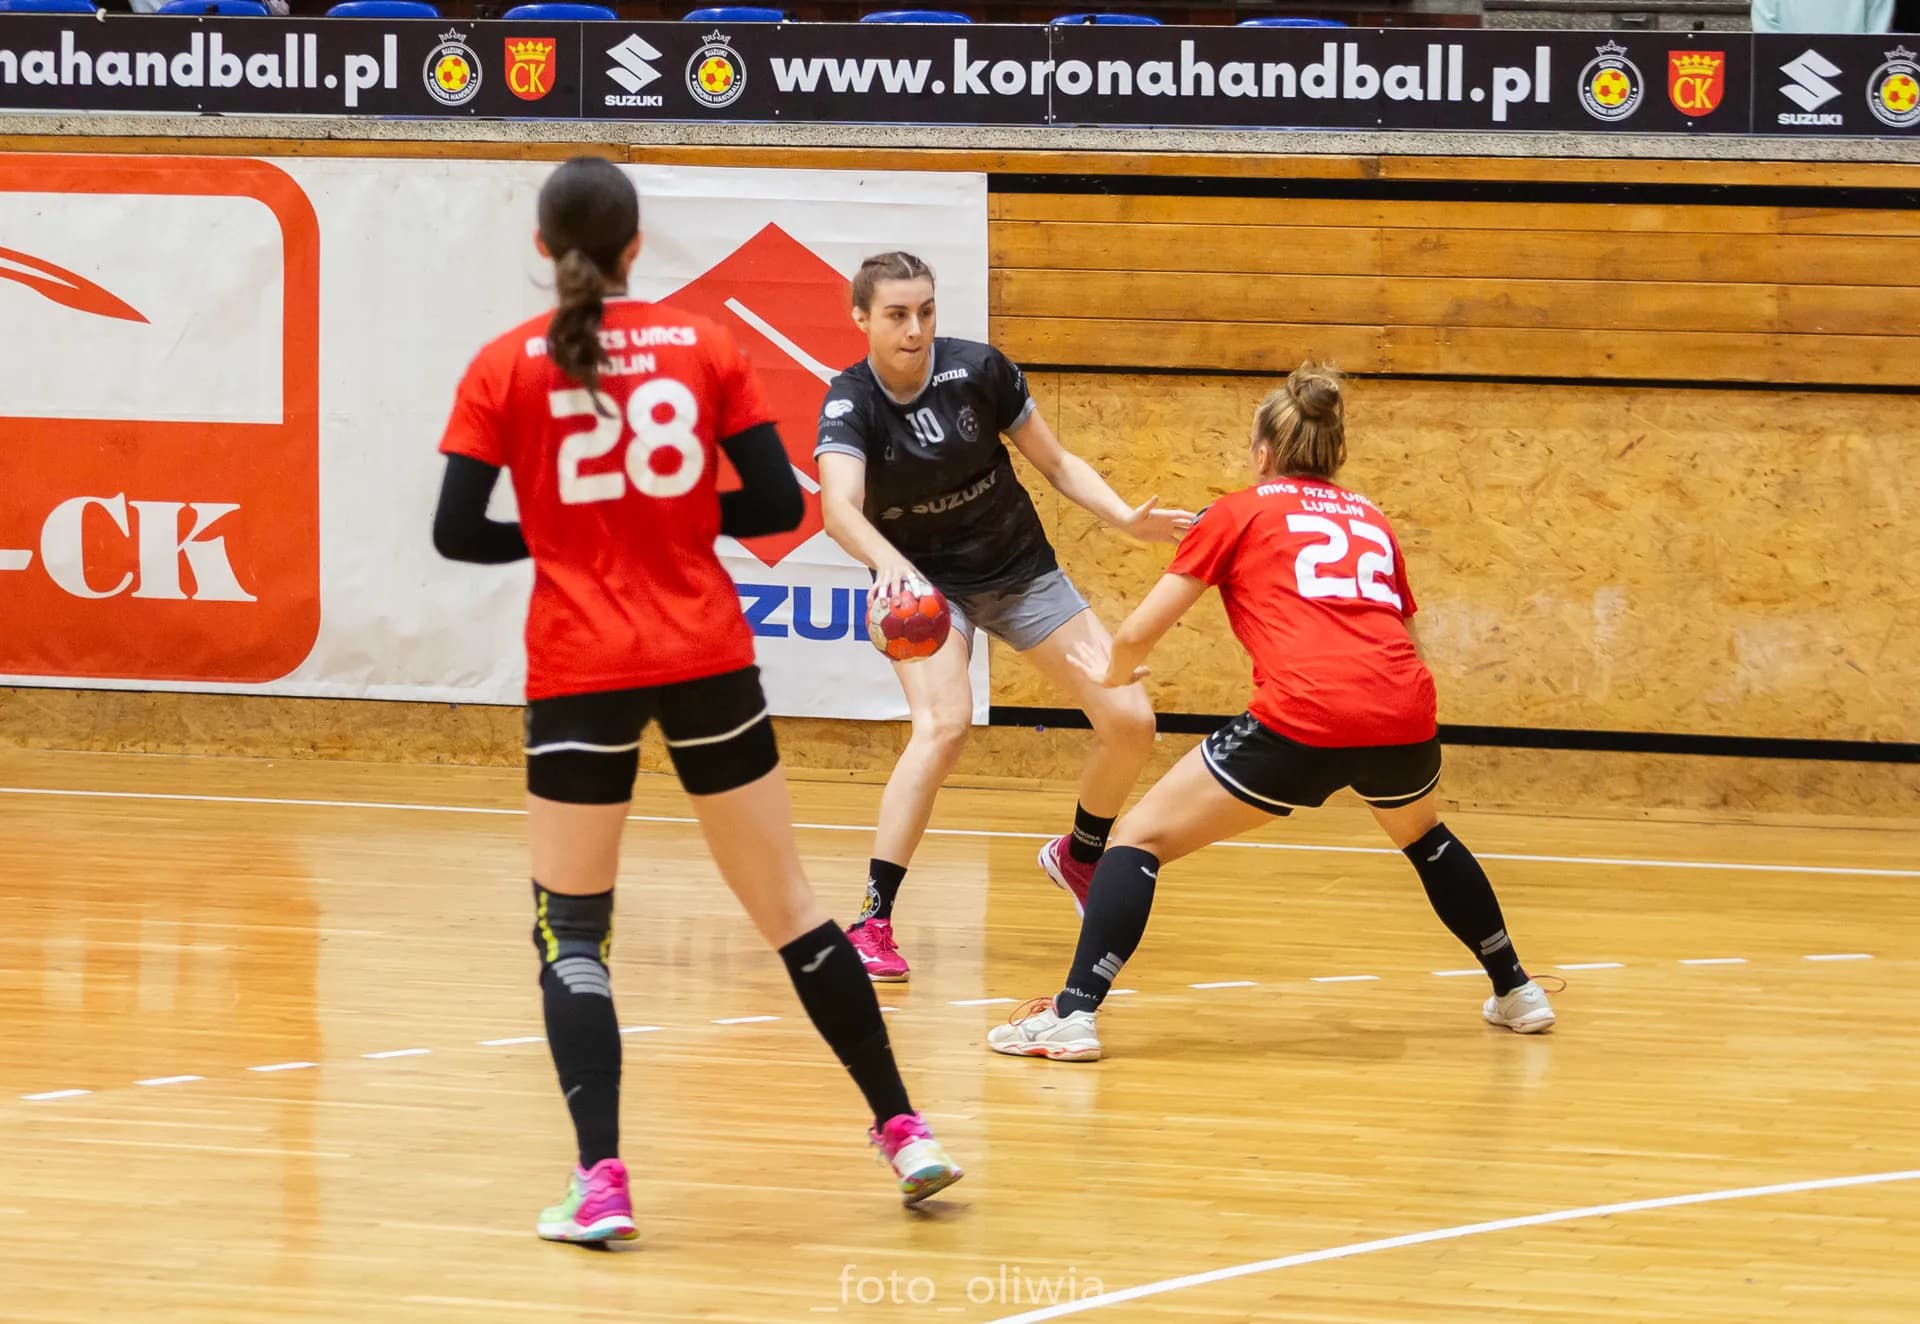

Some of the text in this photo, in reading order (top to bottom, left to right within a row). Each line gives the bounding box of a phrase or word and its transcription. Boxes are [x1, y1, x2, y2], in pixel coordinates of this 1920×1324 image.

[510, 62, 546, 93] CK
[769, 38, 1551, 122] www.koronahandball.pl
[1673, 77, 1713, 109] CK
[604, 95, 663, 107] SUZUKI
[1777, 113, 1843, 125] SUZUKI
[630, 325, 698, 347] UMCS
[549, 377, 705, 505] 28
[905, 407, 945, 447] 10
[1256, 483, 1298, 497] MKS
[1302, 486, 1337, 500] AZS
[1300, 499, 1365, 518] LUBLIN
[1285, 514, 1403, 612] 22
